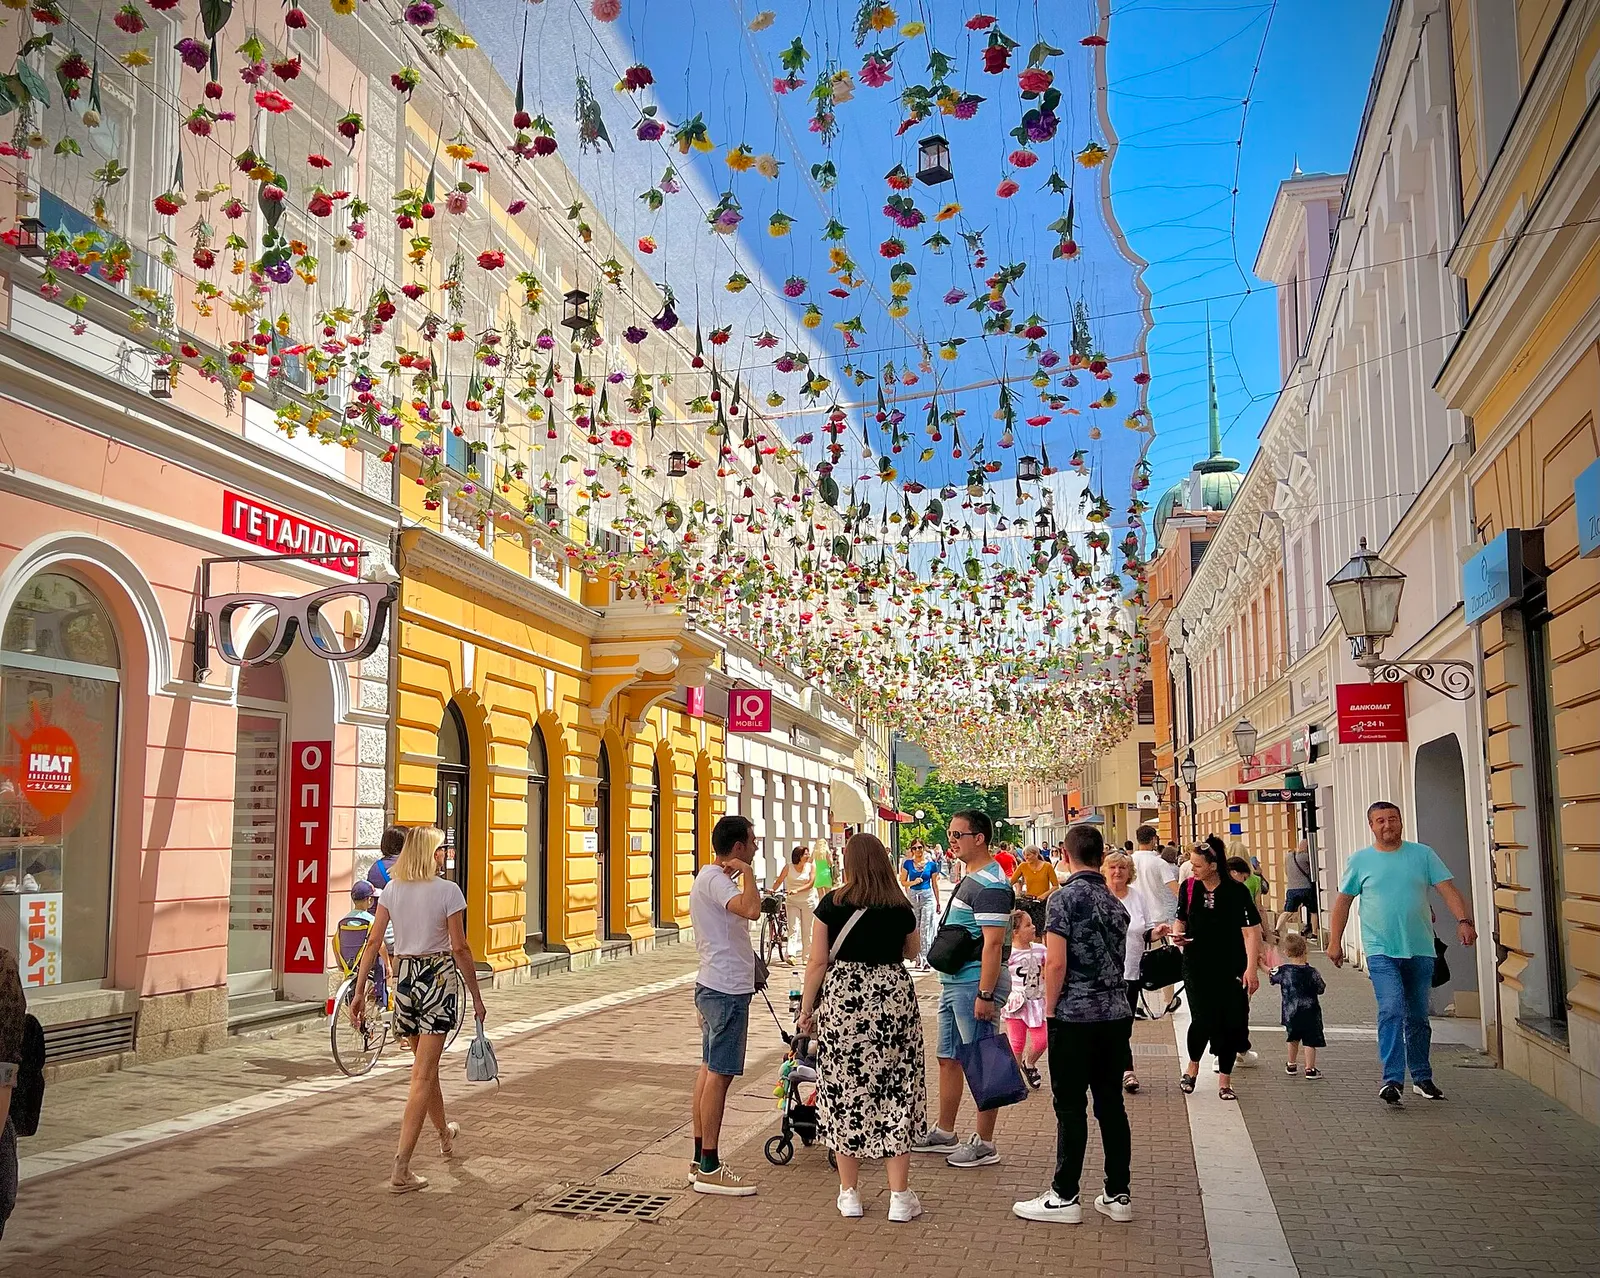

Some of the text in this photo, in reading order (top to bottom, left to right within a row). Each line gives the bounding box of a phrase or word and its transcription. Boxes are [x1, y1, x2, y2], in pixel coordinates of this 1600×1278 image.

[233, 500, 355, 567] ГЕТАЛДУС
[736, 695, 764, 720] IQ
[29, 753, 73, 773] HEAT
[293, 746, 322, 961] ОПТИКА
[27, 901, 46, 987] HEAT
[47, 901, 57, 985] HOT HOT
